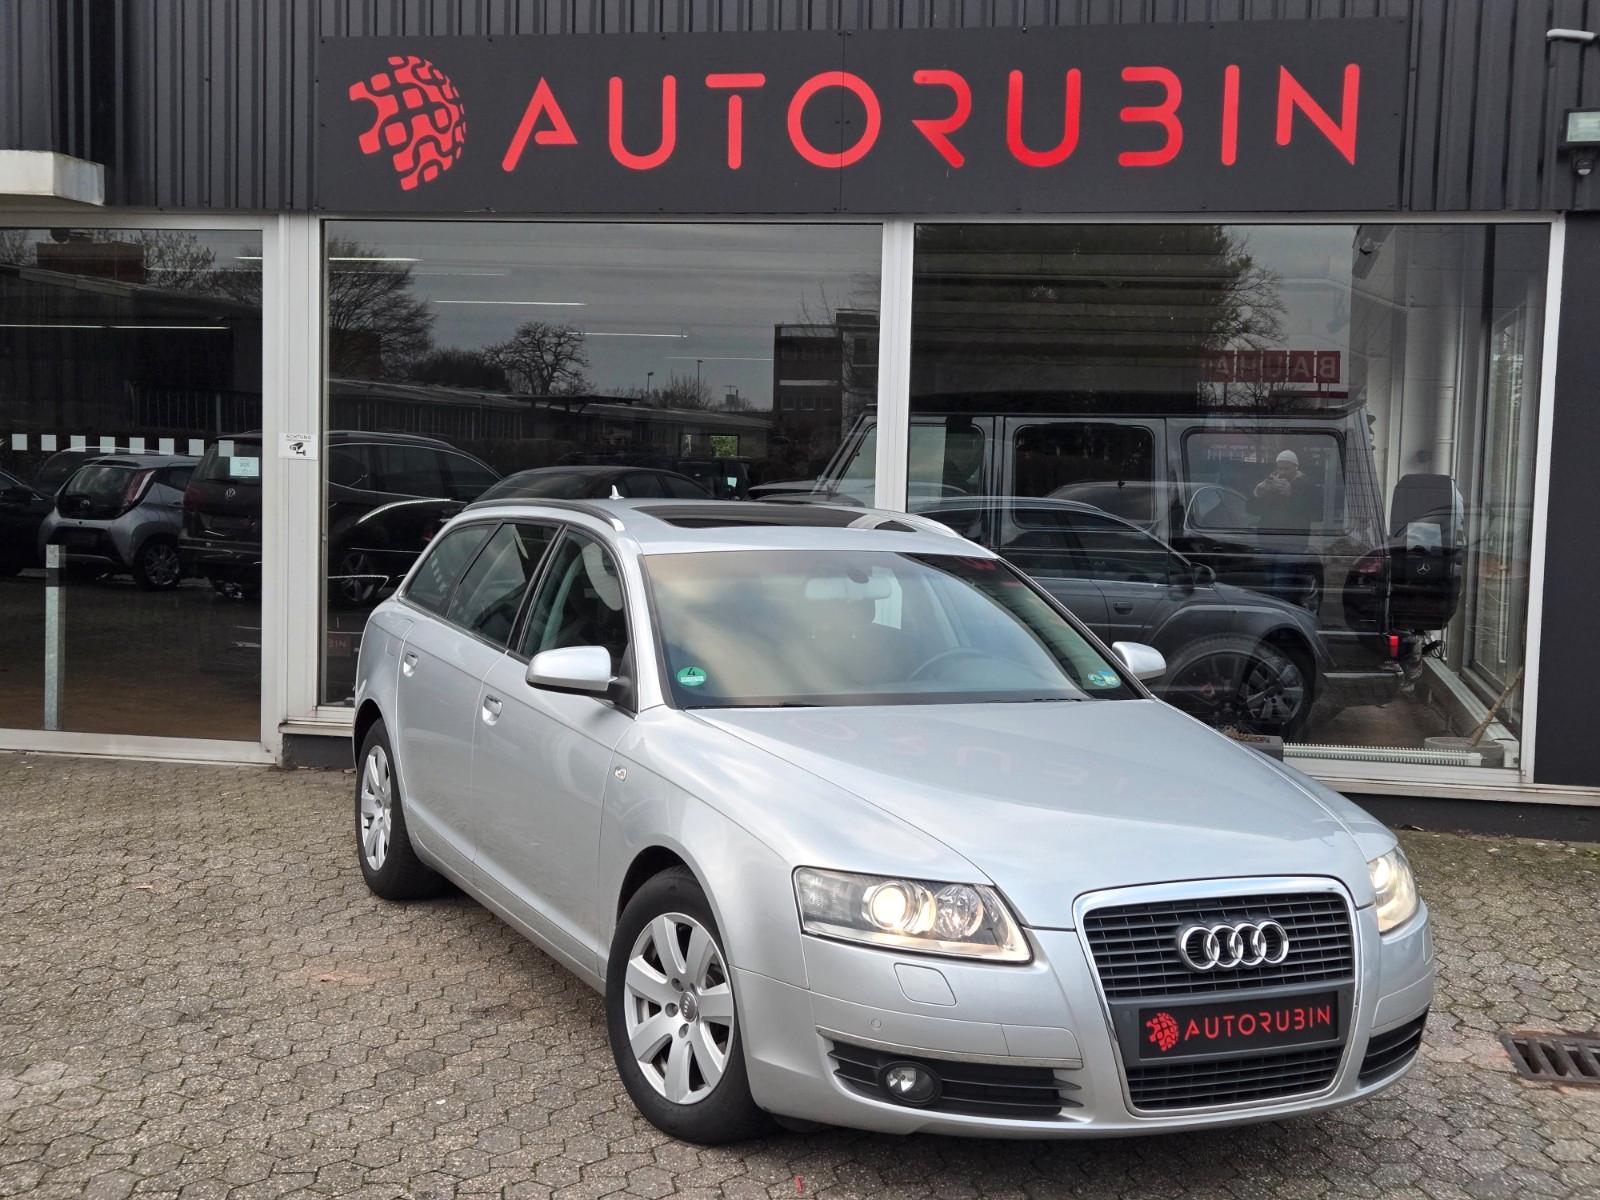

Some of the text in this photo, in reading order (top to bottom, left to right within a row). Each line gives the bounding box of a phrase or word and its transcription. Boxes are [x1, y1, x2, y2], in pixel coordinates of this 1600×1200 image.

[502, 64, 1360, 172] AUTORUBIN
[686, 667, 696, 676] 4
[1184, 1005, 1331, 1040] AUTORUBIN
